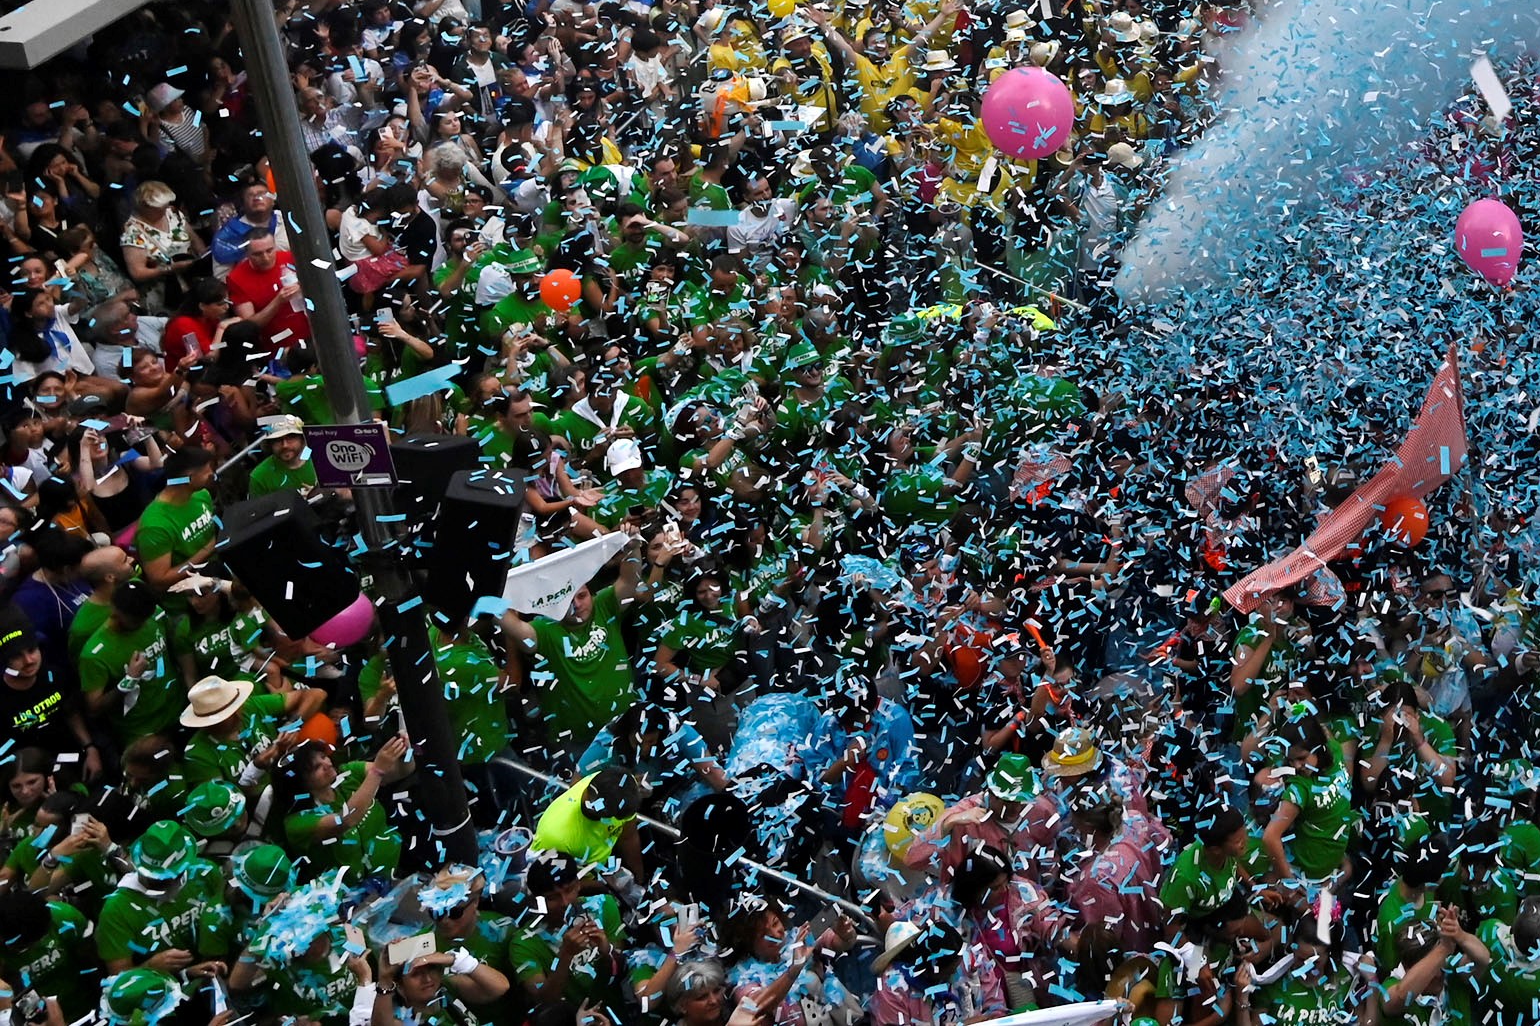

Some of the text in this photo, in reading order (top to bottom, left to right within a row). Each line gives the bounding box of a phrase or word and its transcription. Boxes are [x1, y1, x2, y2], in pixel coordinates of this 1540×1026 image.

[330, 443, 356, 453] Ono
[332, 452, 364, 463] WiFi
[531, 597, 544, 608] LA
[546, 584, 573, 603] PERA
[1, 629, 22, 644] OTROS
[211, 628, 230, 645] PE
[144, 636, 166, 658] ERA
[33, 692, 61, 715] OTROS
[170, 906, 201, 930] PER
[1276, 1003, 1296, 1022] LA
